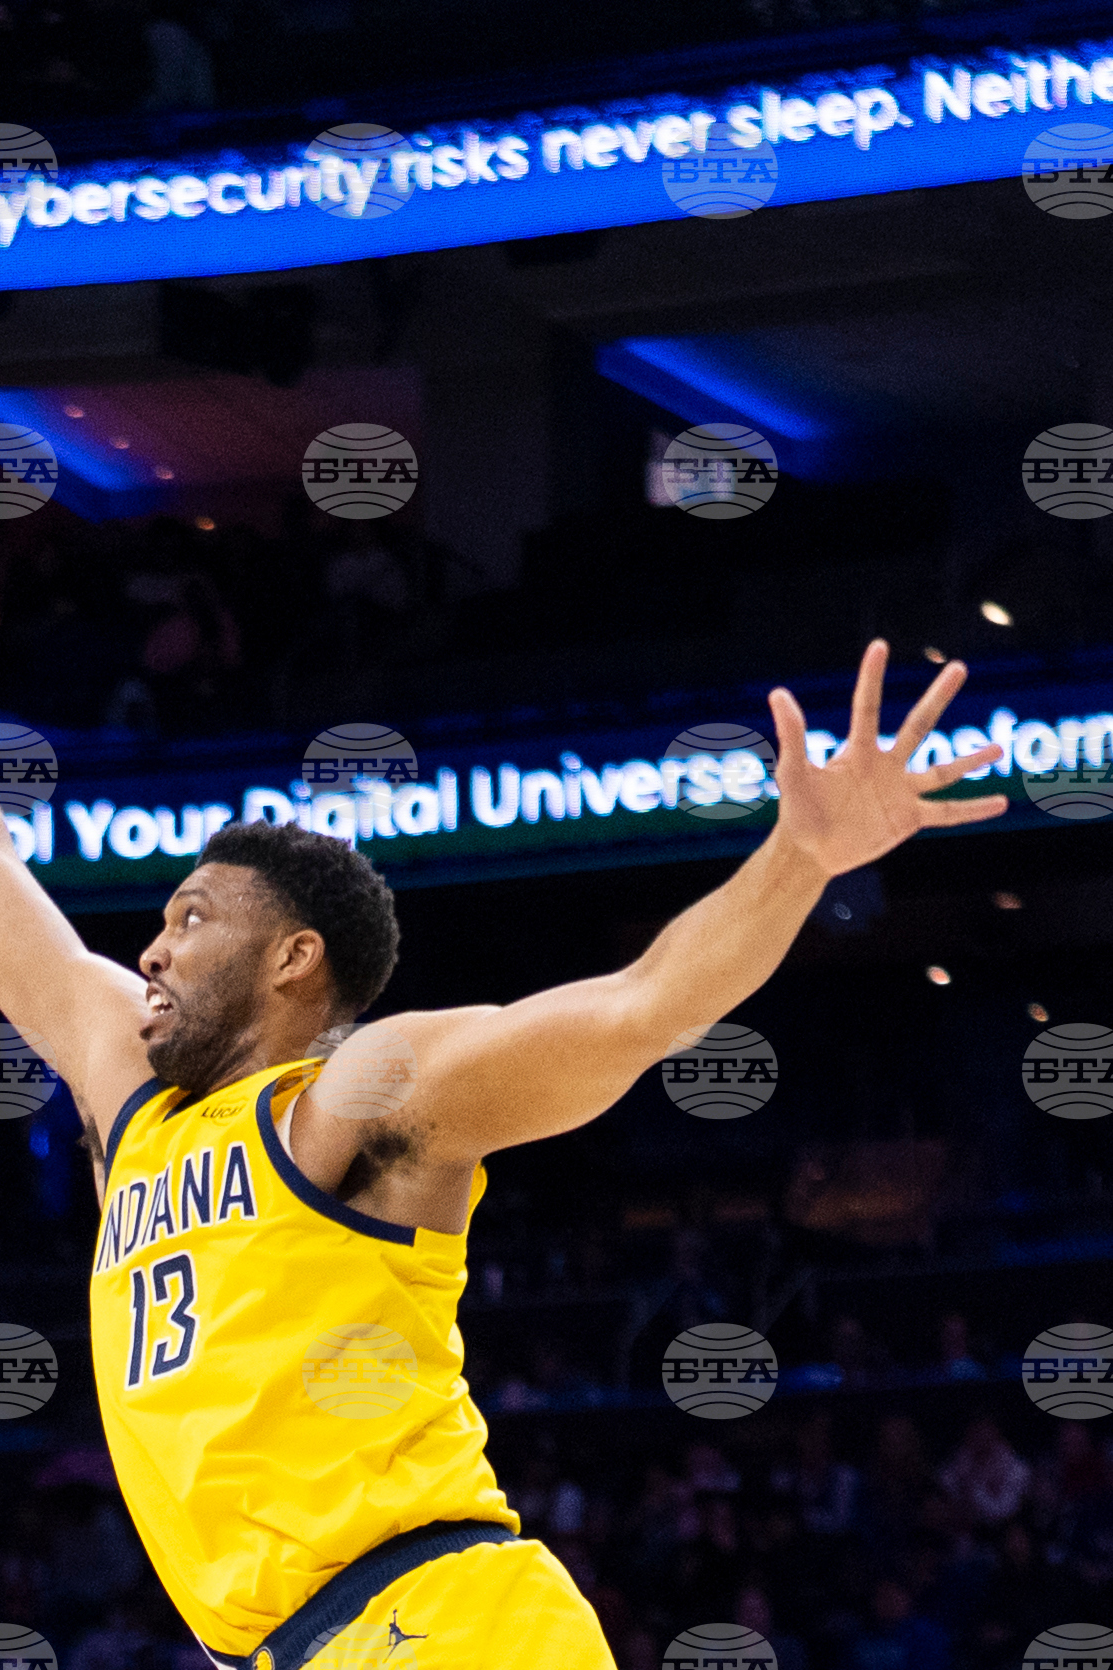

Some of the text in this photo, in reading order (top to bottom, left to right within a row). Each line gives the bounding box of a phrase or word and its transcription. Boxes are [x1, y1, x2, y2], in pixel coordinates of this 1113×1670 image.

[390, 130, 529, 192] risks
[541, 111, 716, 173] never
[727, 87, 914, 150] sleep.
[125, 1250, 201, 1391] 13
